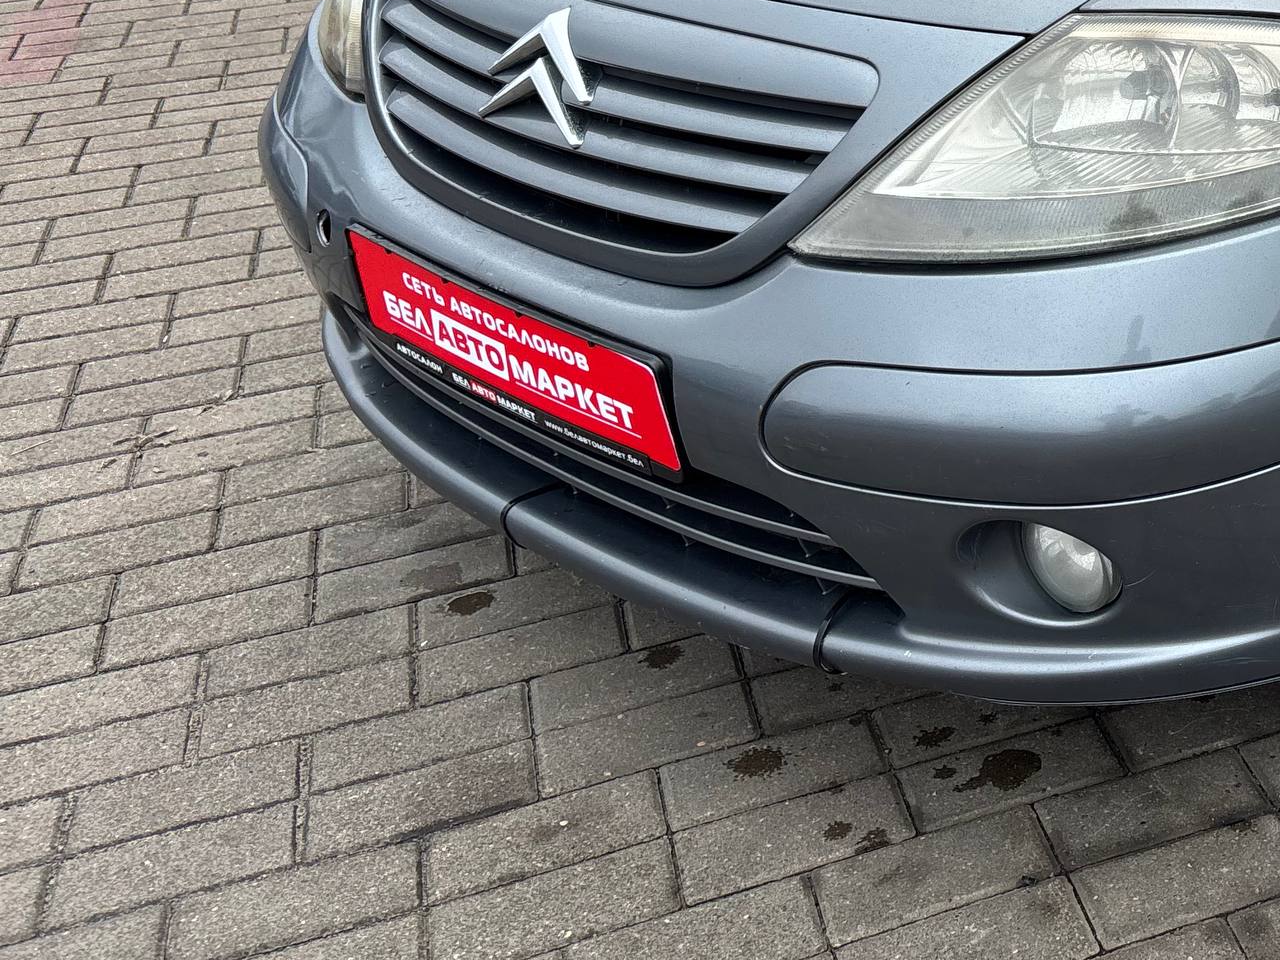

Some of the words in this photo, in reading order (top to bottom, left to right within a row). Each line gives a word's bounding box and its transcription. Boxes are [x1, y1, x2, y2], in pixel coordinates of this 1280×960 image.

[402, 272, 445, 306] СЕТЬ
[450, 296, 590, 372] АВТОСАЛОНОВ
[396, 343, 443, 374] АВТОСАЛОН
